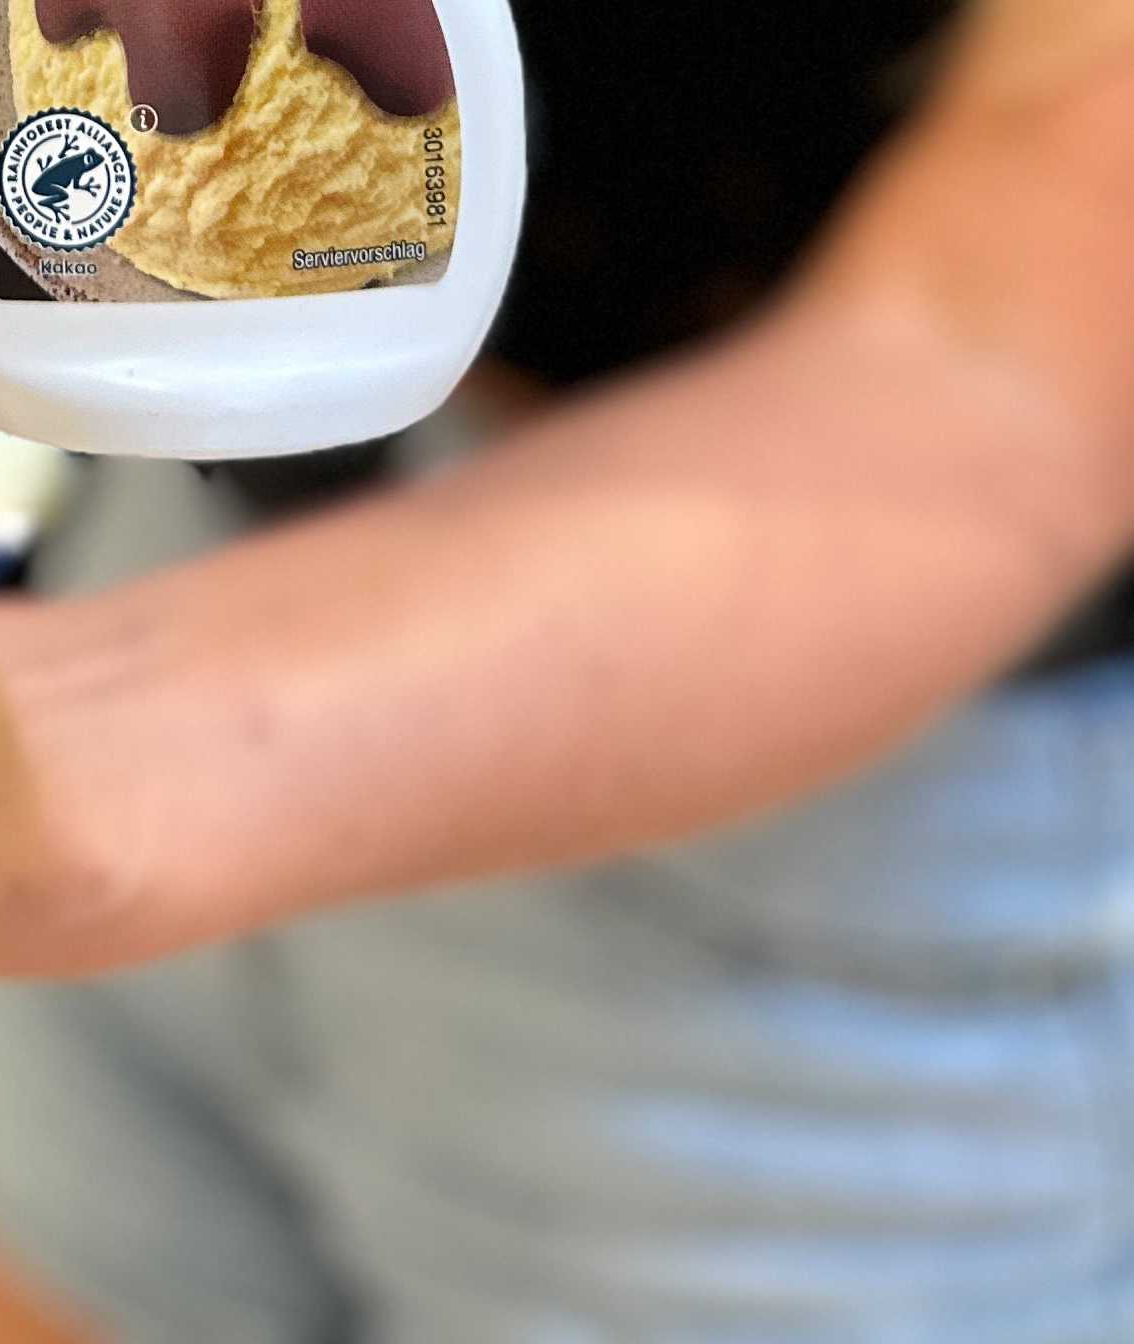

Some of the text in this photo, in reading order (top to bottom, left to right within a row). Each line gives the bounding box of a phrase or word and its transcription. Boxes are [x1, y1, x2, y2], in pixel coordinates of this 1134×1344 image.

[7, 118, 126, 184] RAINFOREST ALLIANCE
[423, 126, 447, 228] 30163981
[11, 196, 60, 240] PEOPLE
[76, 195, 123, 240] NATURE
[40, 259, 98, 275] Kakao
[292, 240, 427, 270] Serviervorschlag
